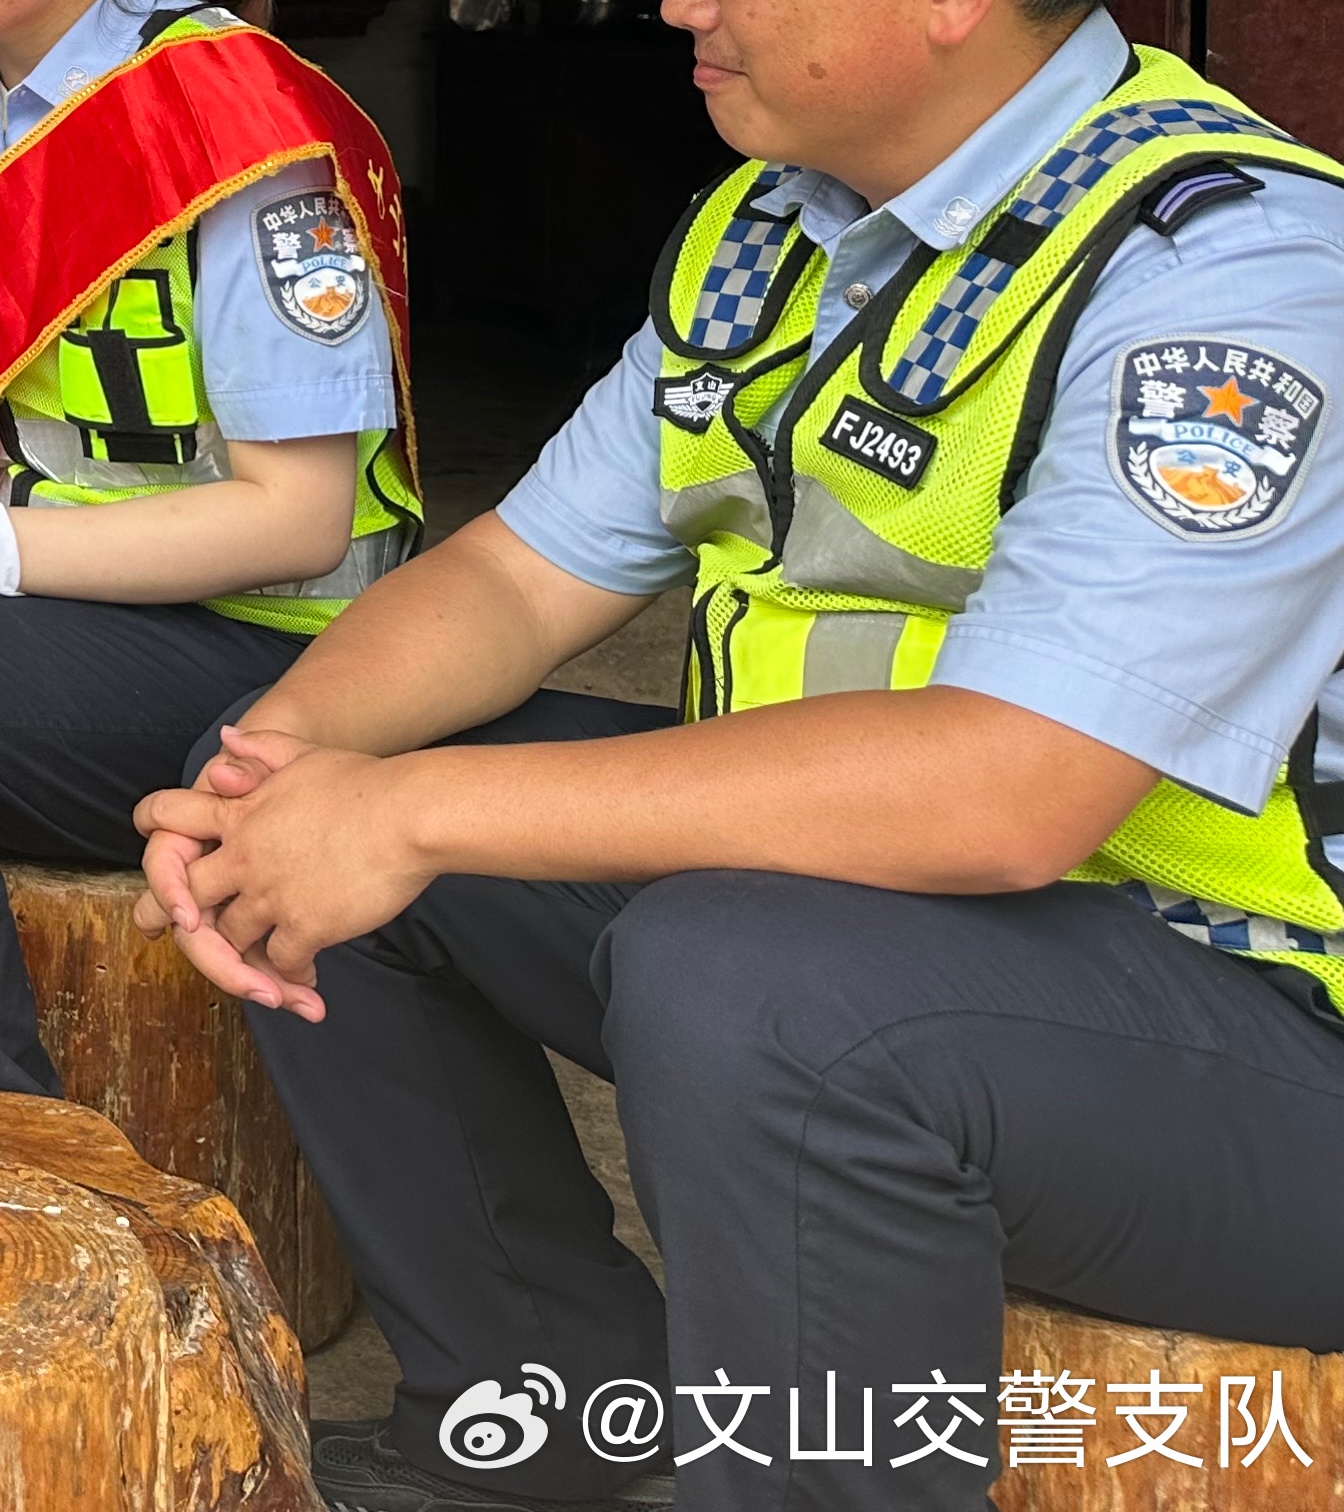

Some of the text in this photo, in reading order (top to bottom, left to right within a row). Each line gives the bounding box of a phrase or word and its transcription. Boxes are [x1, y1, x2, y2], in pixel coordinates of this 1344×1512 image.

[262, 196, 346, 232] 中华人民共
[302, 257, 348, 273] POLICE
[1132, 345, 1319, 420] 中华人民共和国
[832, 409, 922, 476] FJ2493
[1174, 423, 1256, 458] POLICE
